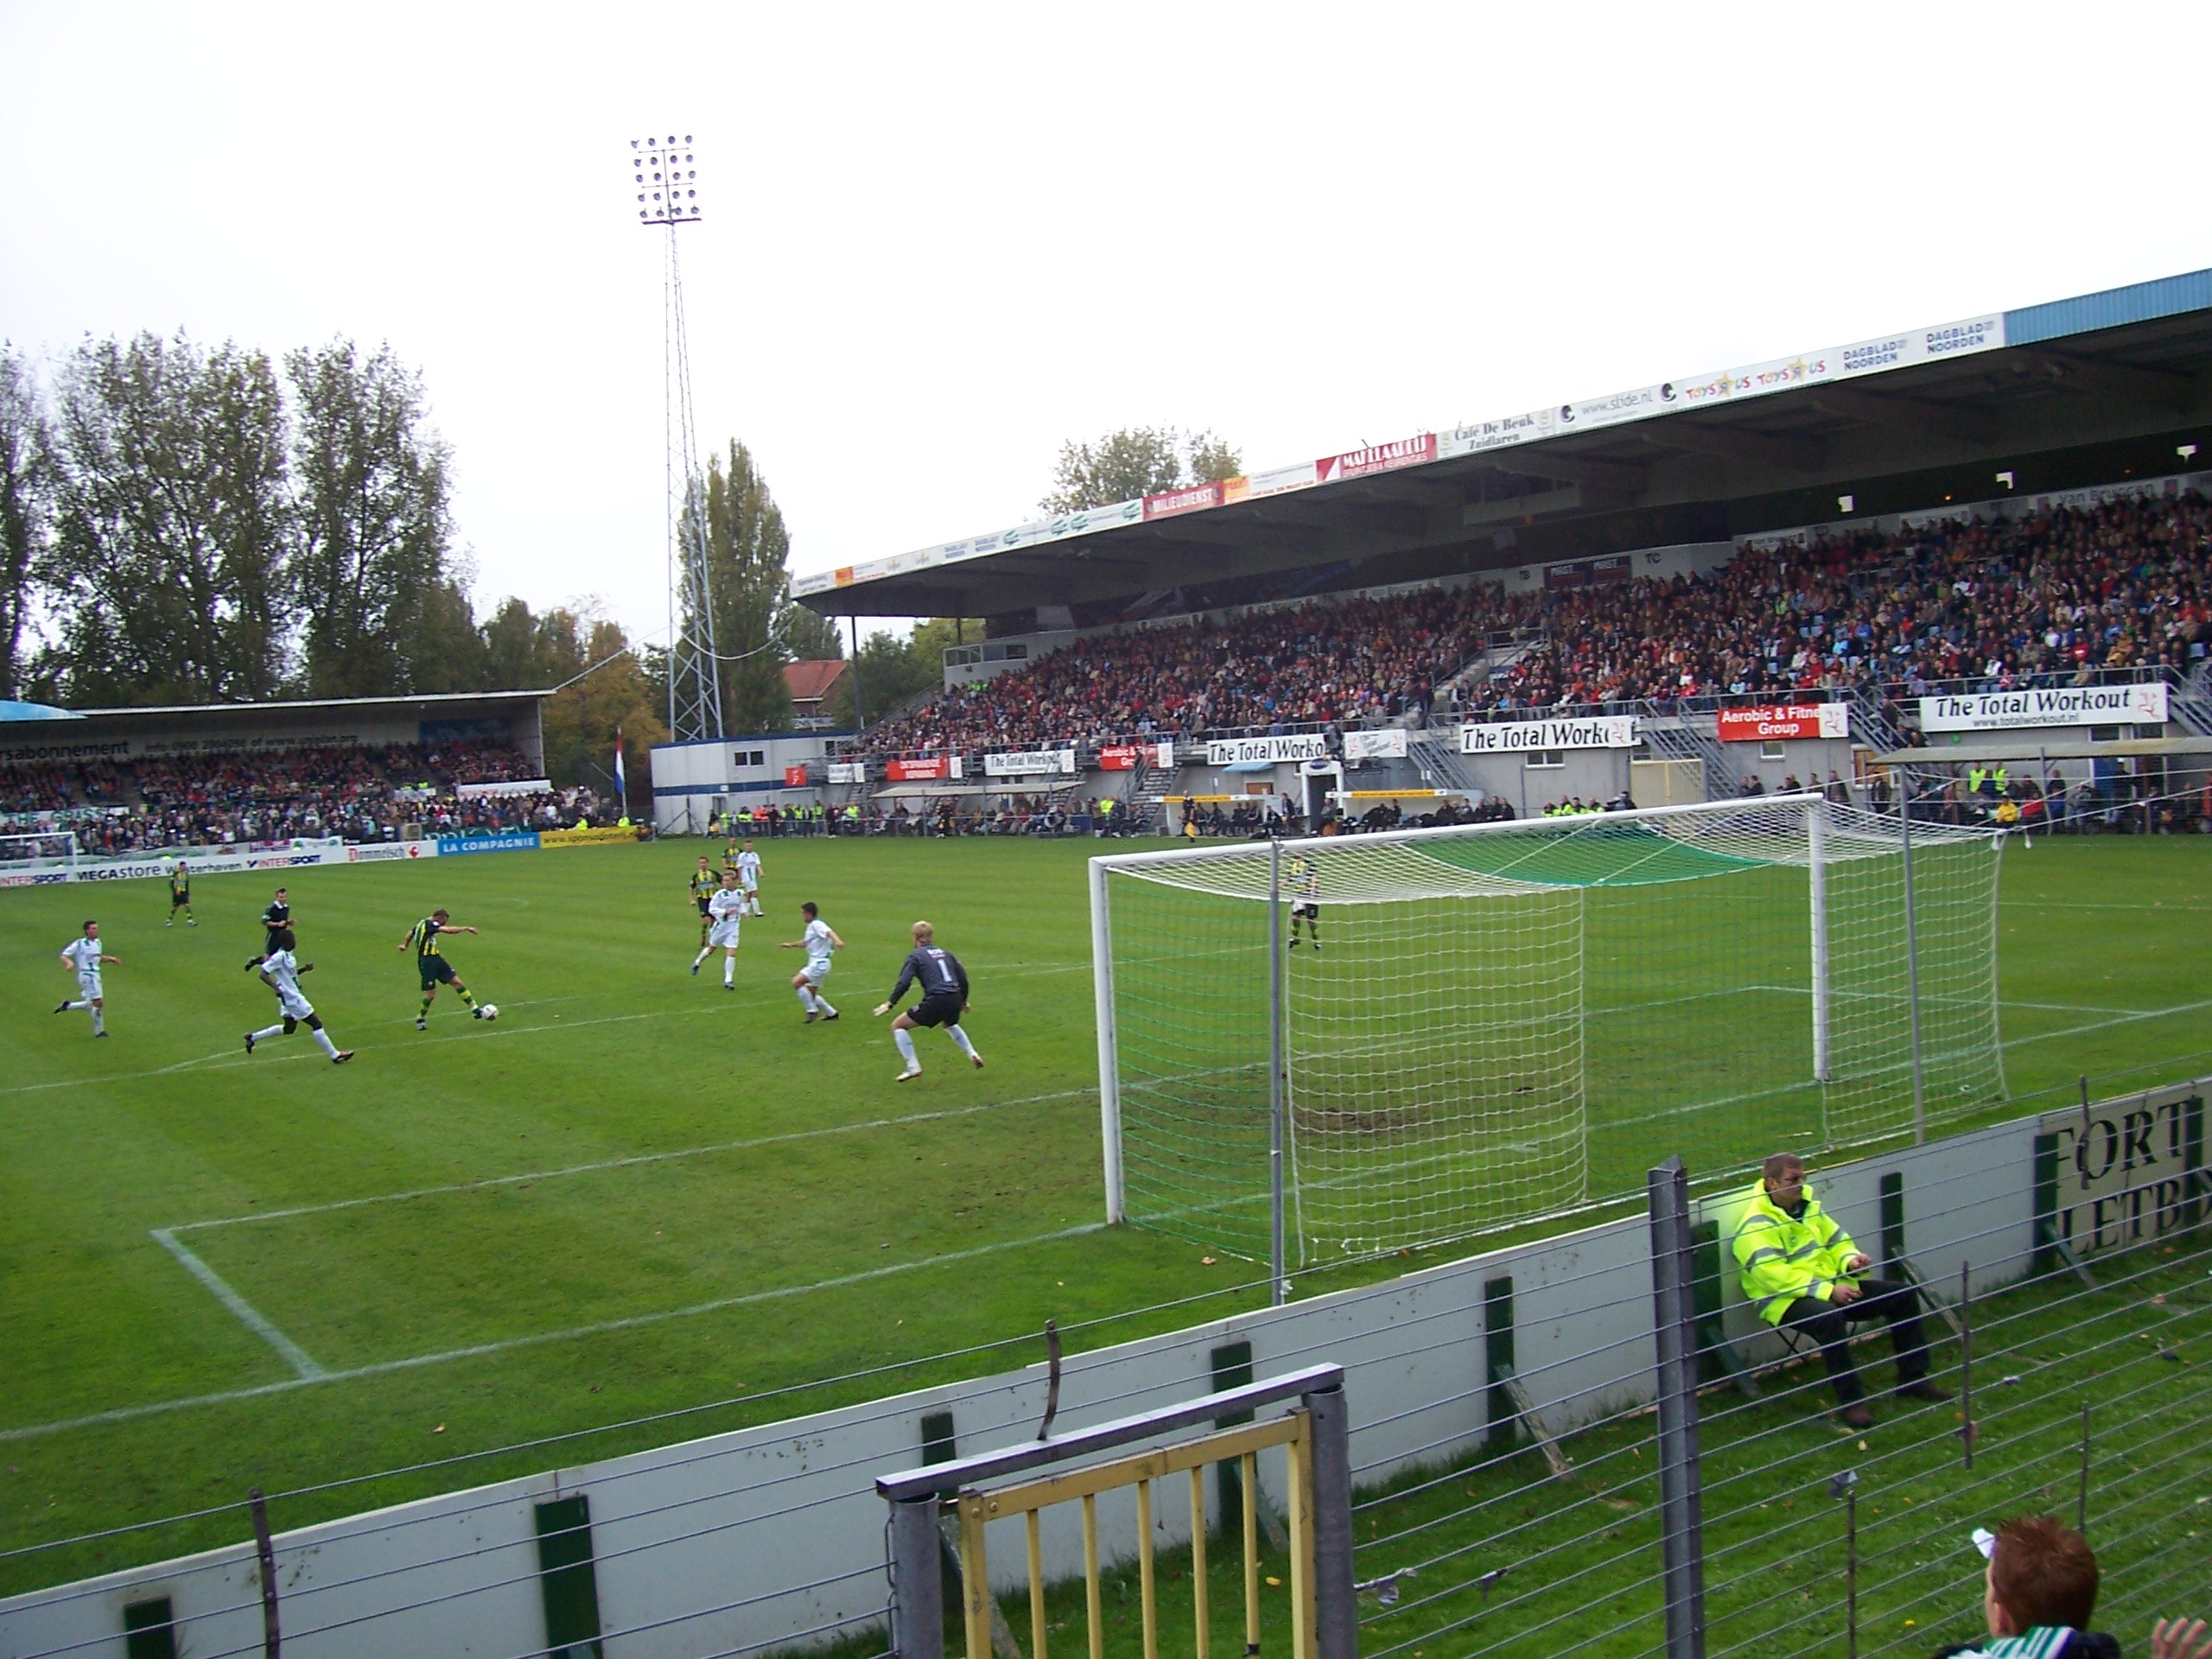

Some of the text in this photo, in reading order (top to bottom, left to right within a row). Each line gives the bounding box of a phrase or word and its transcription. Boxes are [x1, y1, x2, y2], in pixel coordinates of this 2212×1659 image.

[1926, 323, 1983, 343] DAGBLAD
[1843, 341, 1897, 361] DAGBLAD
[1927, 334, 1985, 355] NOORDEN
[1844, 352, 1898, 372] NOORDEN
[1757, 368, 1789, 386] TOYS
[1809, 359, 1826, 374] US
[1685, 383, 1717, 400] TOYS
[1735, 376, 1751, 391] US
[1483, 423, 1499, 435] De
[1503, 413, 1535, 431] Beuk
[1936, 688, 2131, 717] The Total Workout
[1721, 709, 1771, 723] Aerobic
[1774, 707, 1785, 721] &
[1972, 713, 2080, 728] www.totalworkout.nl
[1464, 728, 1497, 750] The
[1502, 723, 1546, 748] Total
[1758, 721, 1800, 736] Group
[1210, 744, 1234, 762] The
[1238, 740, 1272, 760] Total
[442, 837, 536, 854] LA COMPAGNIE
[165, 861, 243, 874] Wsterhaven
[259, 855, 321, 868] INTERSPORT
[937, 958, 952, 982] 1
